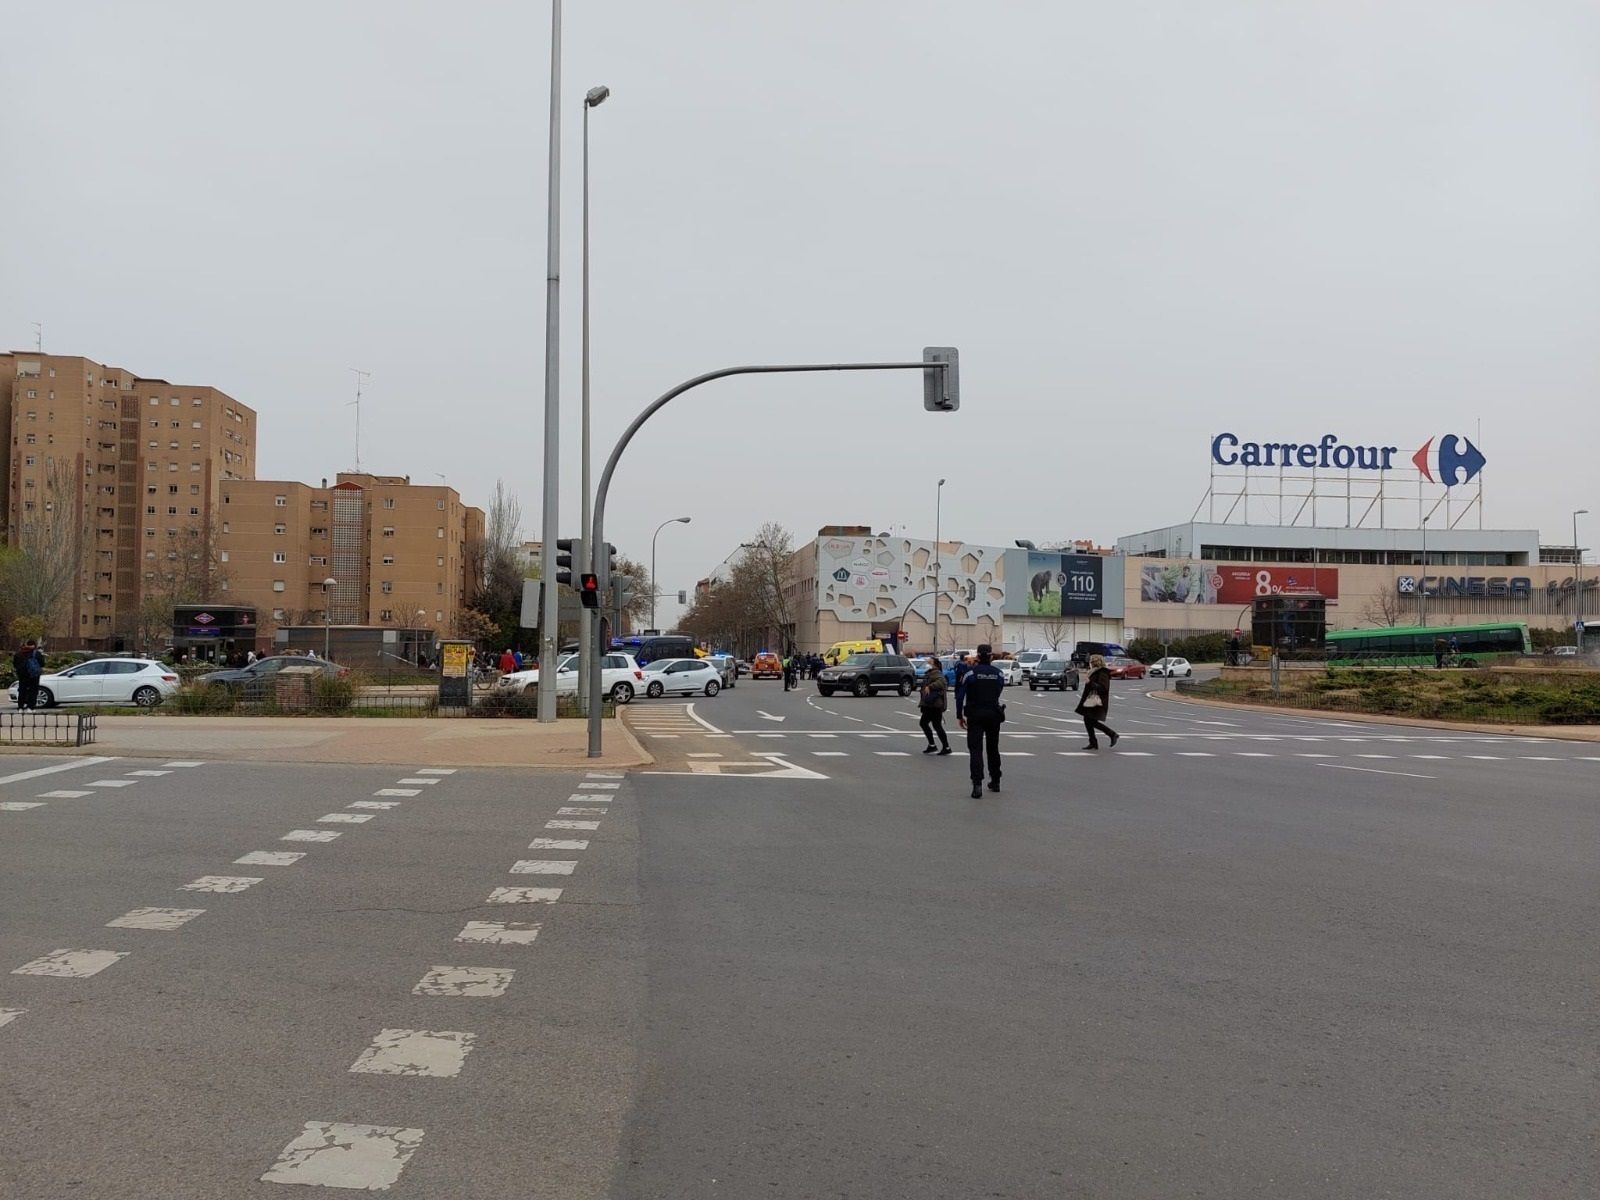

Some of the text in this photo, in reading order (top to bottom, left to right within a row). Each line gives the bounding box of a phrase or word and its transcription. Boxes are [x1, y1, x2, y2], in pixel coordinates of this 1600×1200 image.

[1211, 432, 1397, 470] Carrefour
[1071, 575, 1094, 592] 110
[1416, 577, 1531, 597] CINESA
